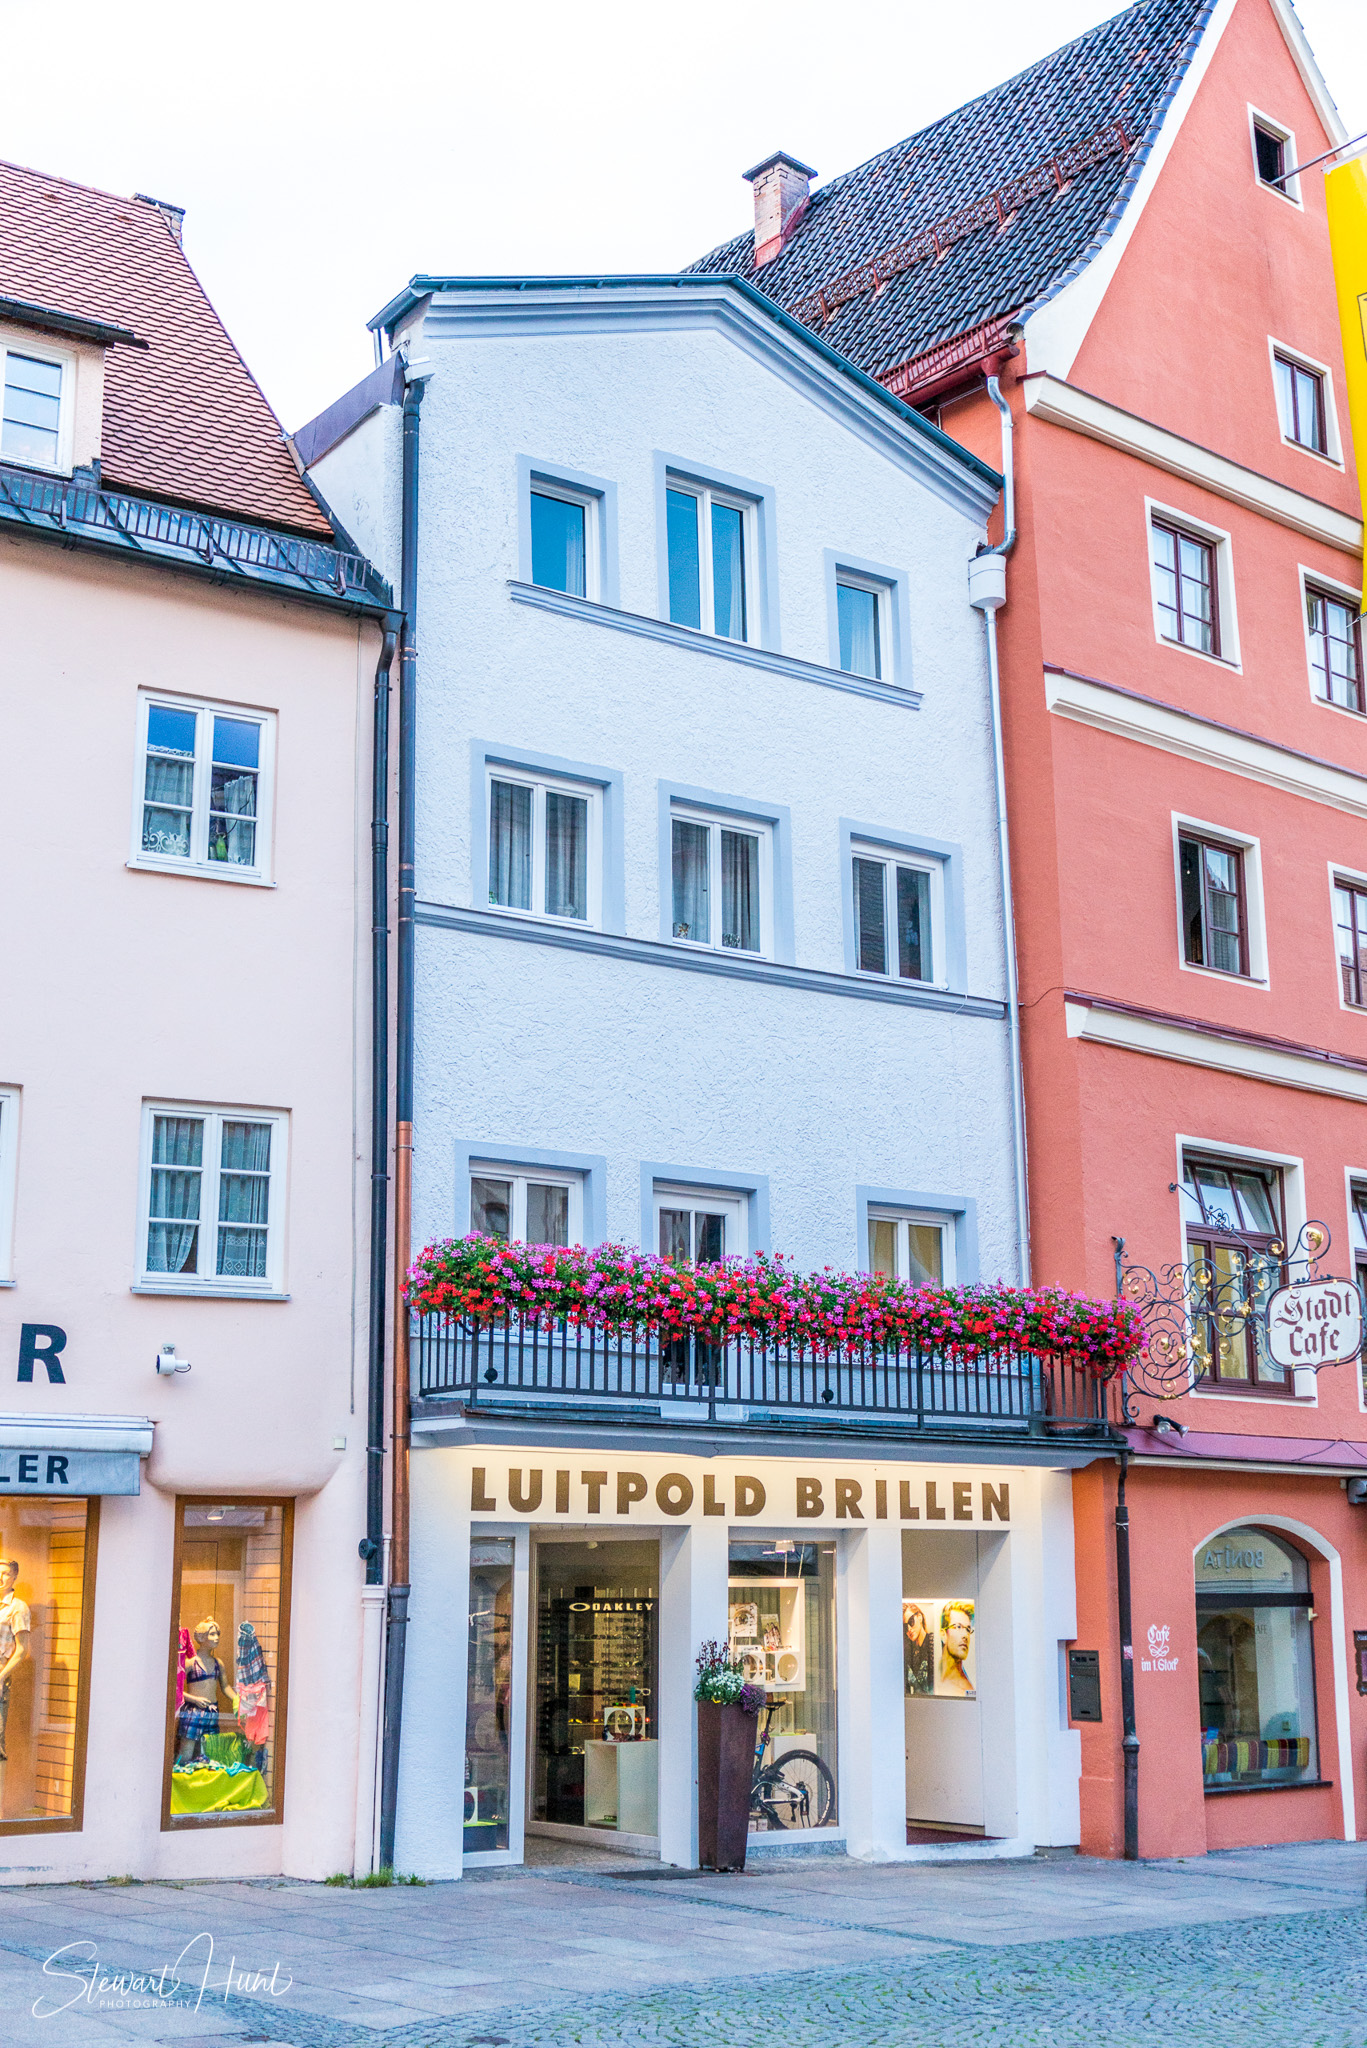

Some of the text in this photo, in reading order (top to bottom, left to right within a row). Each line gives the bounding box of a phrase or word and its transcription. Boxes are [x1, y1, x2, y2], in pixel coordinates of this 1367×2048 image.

[1273, 1289, 1352, 1328] Stadt
[17, 1323, 67, 1384] R
[1289, 1321, 1340, 1360] Cafe
[470, 1467, 1011, 1522] LUITPOLD BRILLEN
[592, 1602, 653, 1611] OAKLEY
[1147, 1624, 1170, 1648] Café
[1141, 1657, 1152, 1672] im
